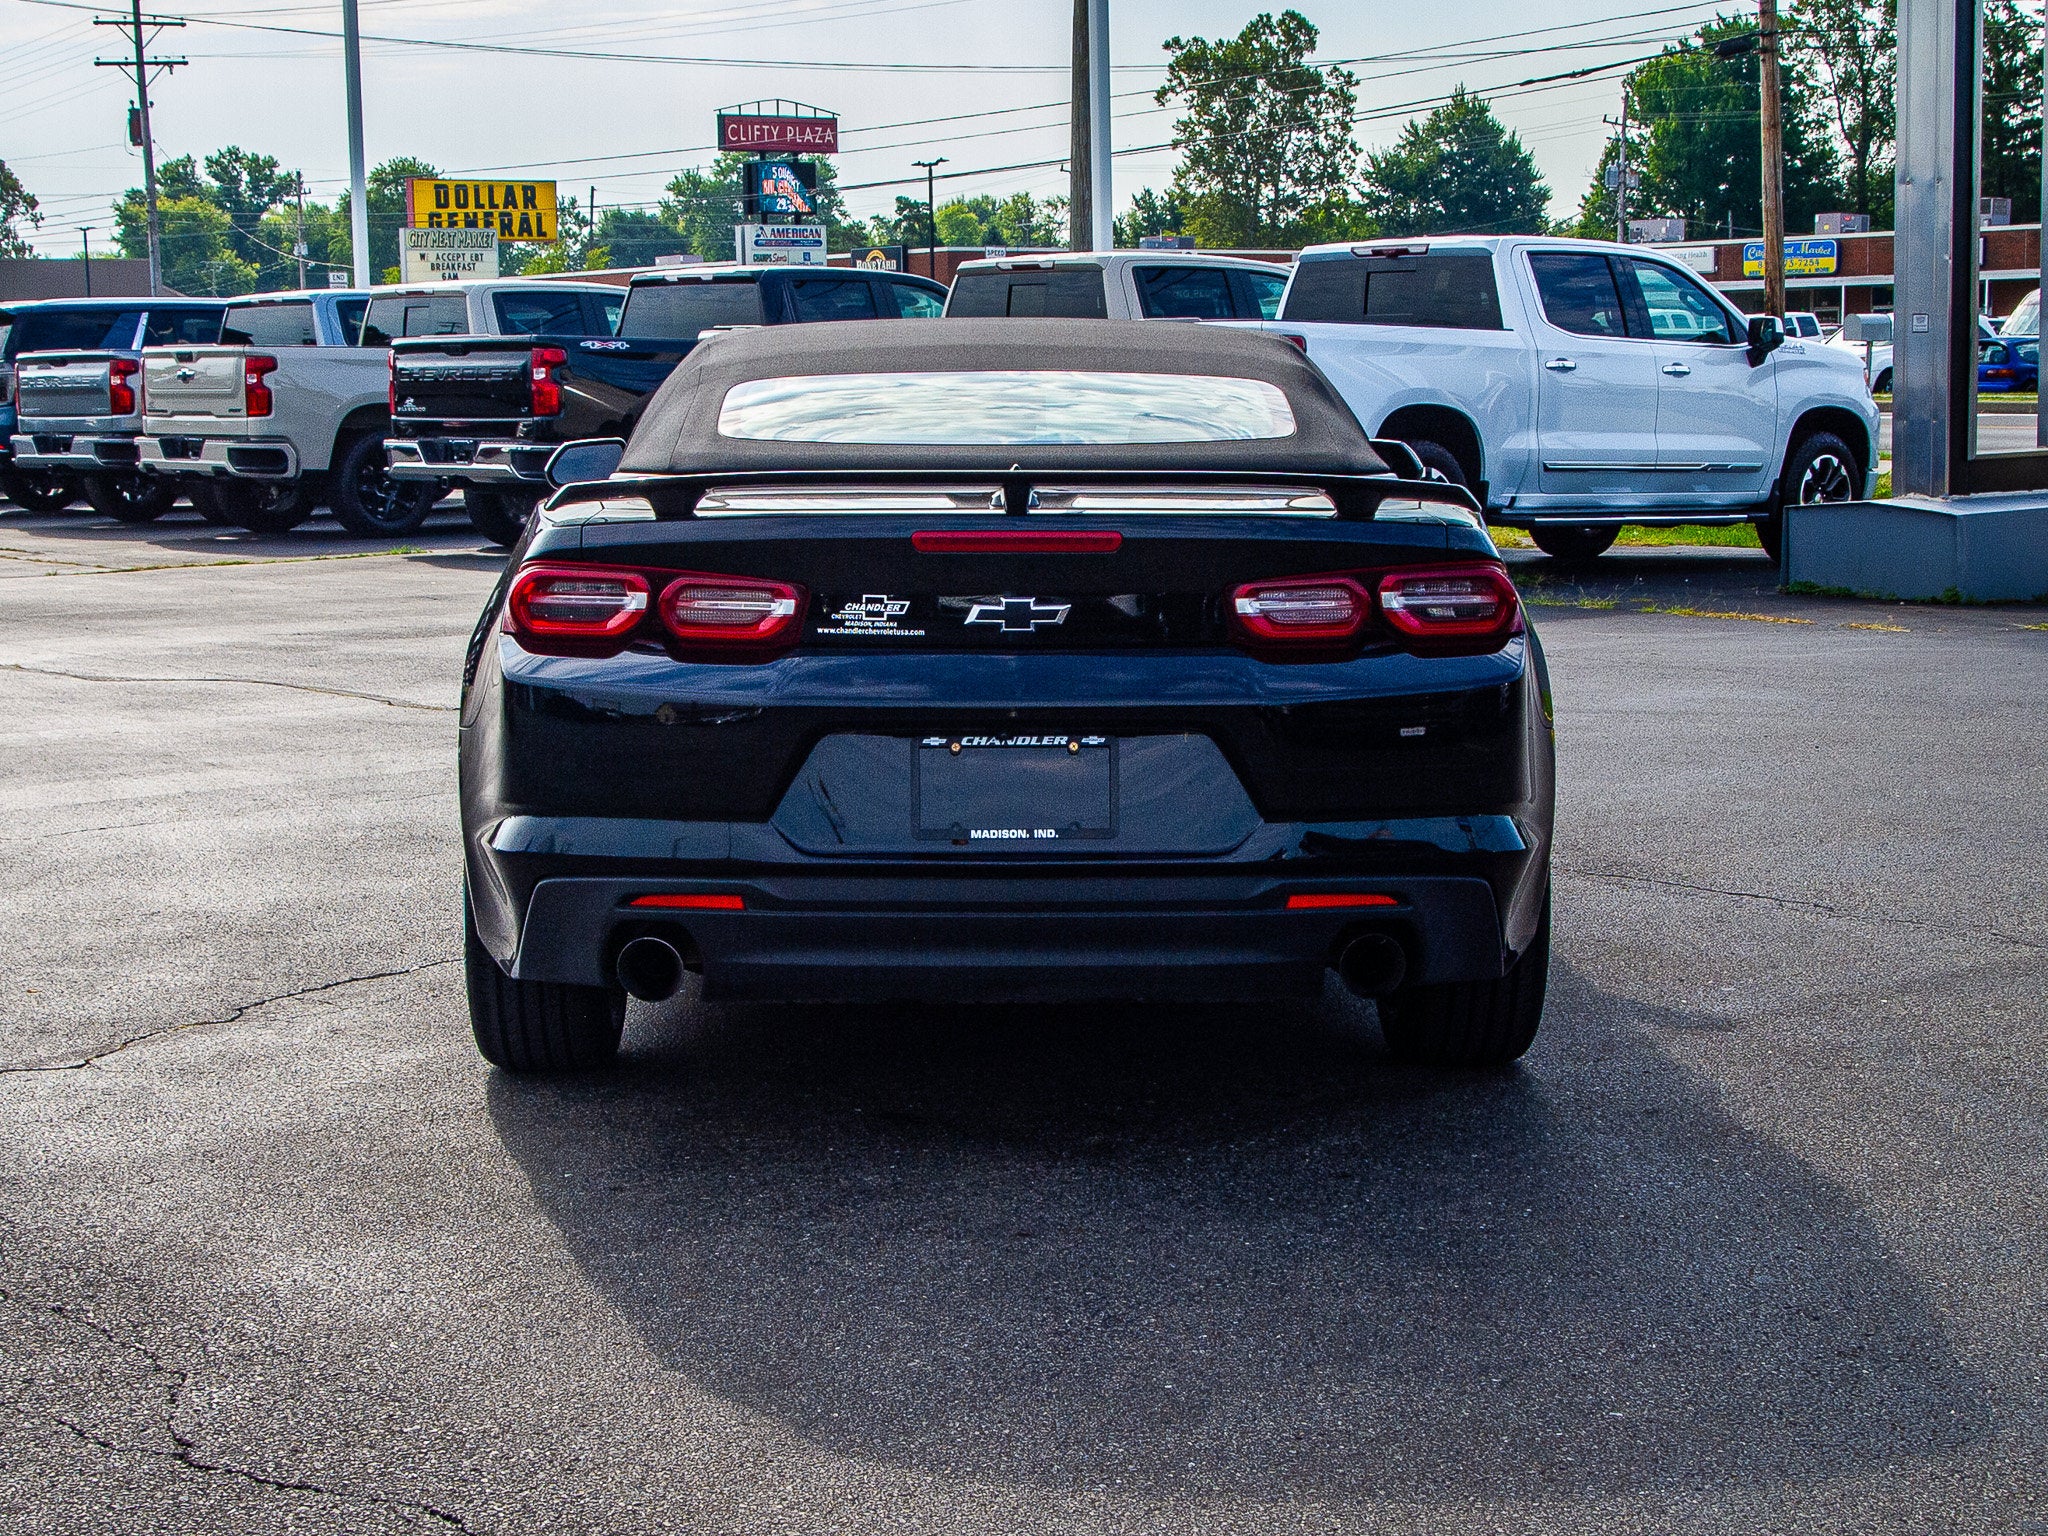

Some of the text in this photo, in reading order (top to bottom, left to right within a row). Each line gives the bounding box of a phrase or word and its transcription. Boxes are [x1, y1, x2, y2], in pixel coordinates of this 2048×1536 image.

[728, 124, 834, 143] CLIFTY PLAZA
[434, 184, 538, 209] DOLLAR
[428, 212, 547, 237] GENERAL
[770, 228, 821, 238] AMERICAN
[408, 231, 495, 248] CITY MEAT MARKET
[435, 253, 465, 262] ACCEPT
[470, 253, 484, 262] EBT
[430, 262, 476, 271] BREAKFAST
[442, 273, 459, 281] 6AM
[399, 367, 524, 382] CHEVROLET
[20, 376, 100, 389] CHEVROLET
[844, 602, 901, 612] CHANDLER
[817, 626, 926, 636] www.chandlerchevroletusa.com
[961, 735, 1068, 746] CHANDLER
[1033, 829, 1059, 838] IND.
